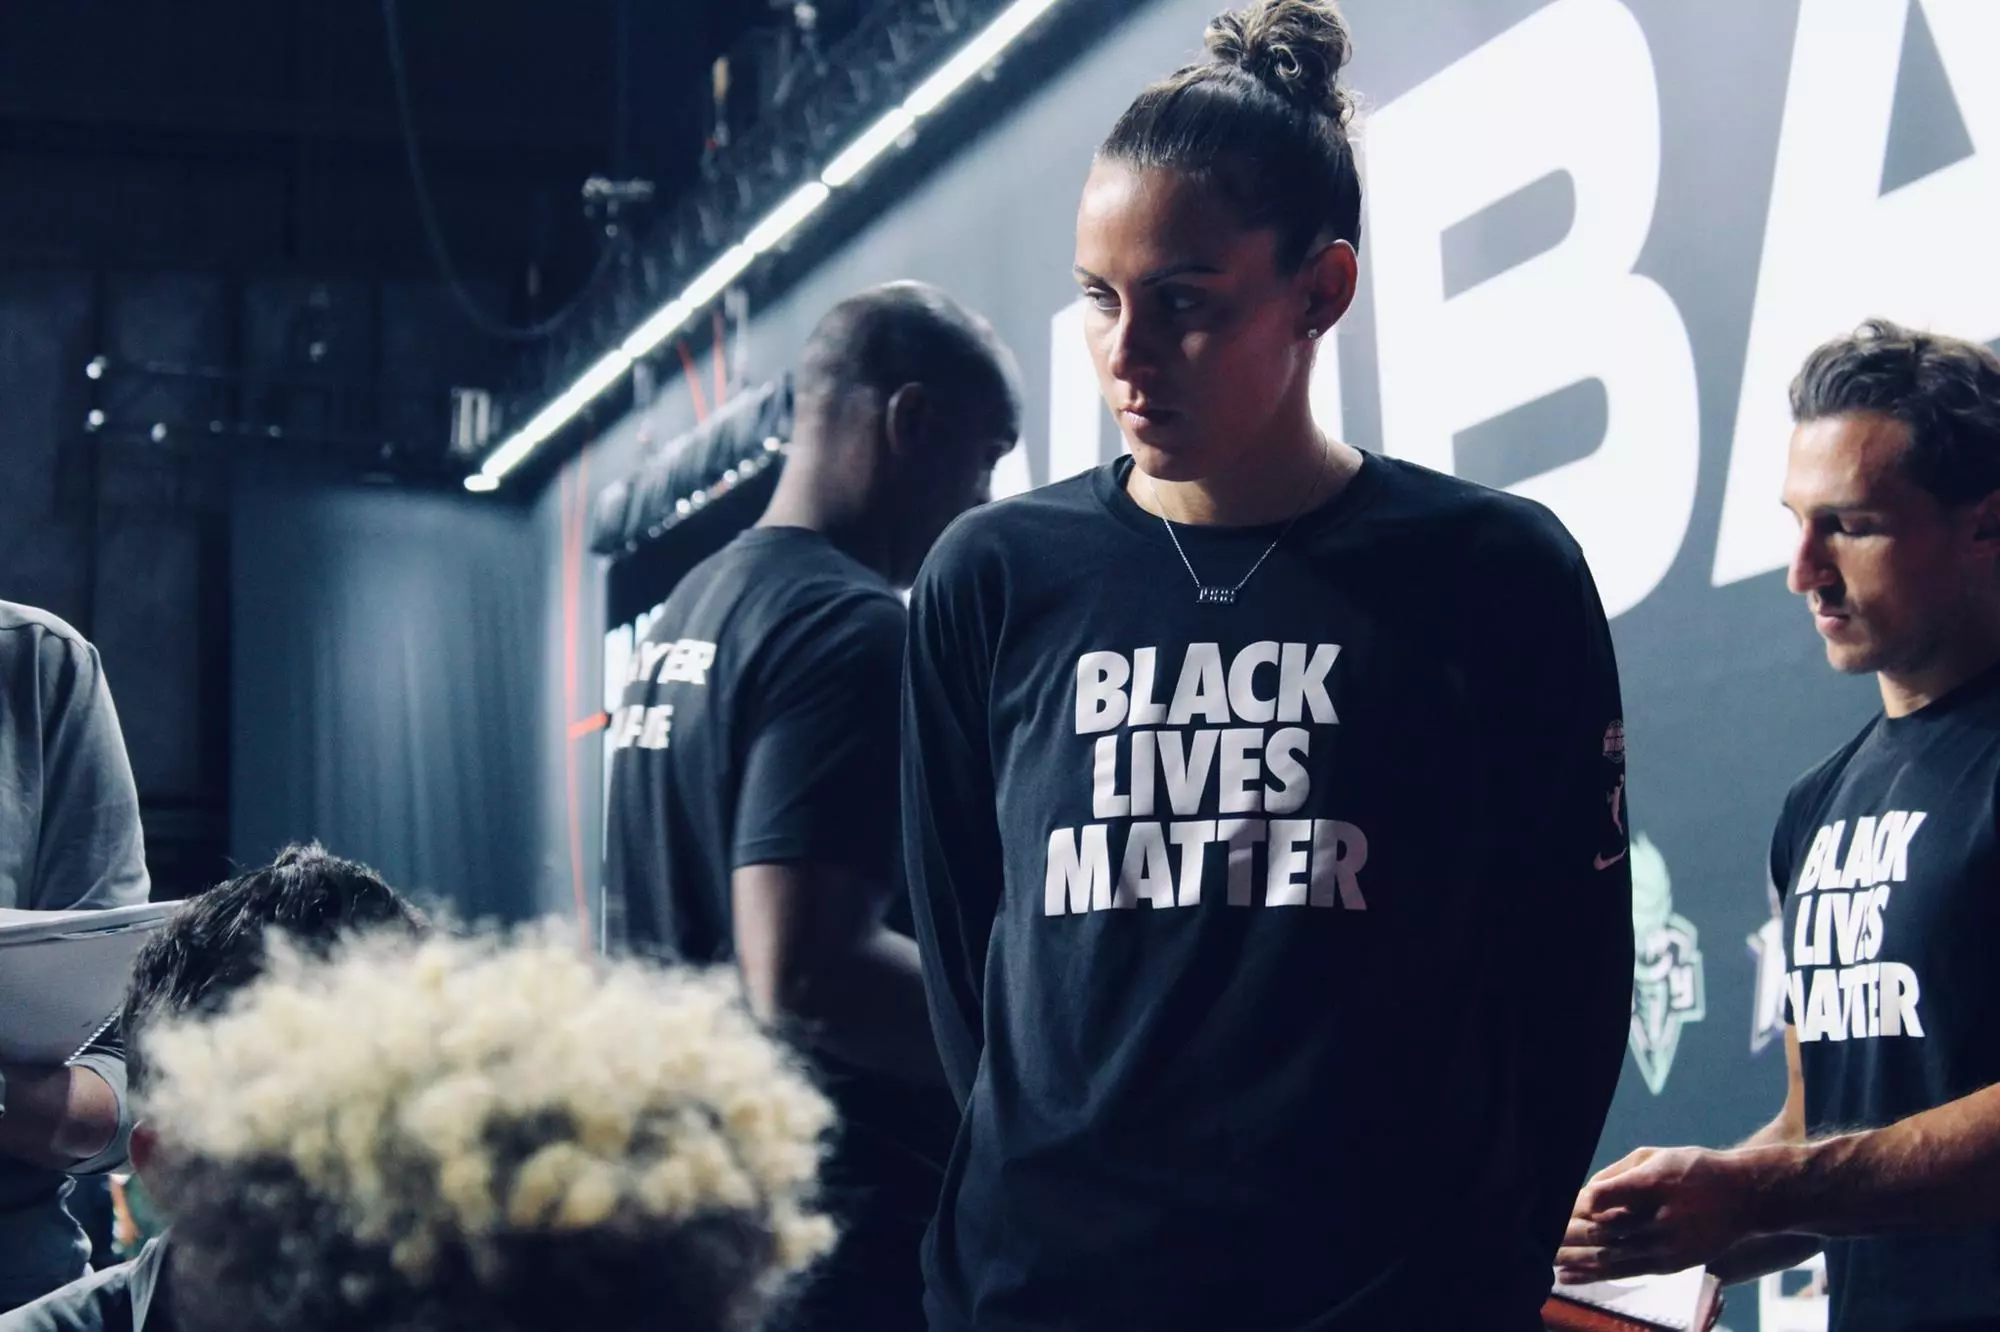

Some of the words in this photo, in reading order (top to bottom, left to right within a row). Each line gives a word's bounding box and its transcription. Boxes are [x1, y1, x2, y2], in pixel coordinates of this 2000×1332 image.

[626, 638, 717, 685] YER
[1075, 640, 1343, 735] BLACK
[1093, 727, 1311, 819] LIVES
[1045, 818, 1369, 917] MATTER
[1795, 810, 1928, 895] BLACK
[1793, 884, 1891, 967] LIVS
